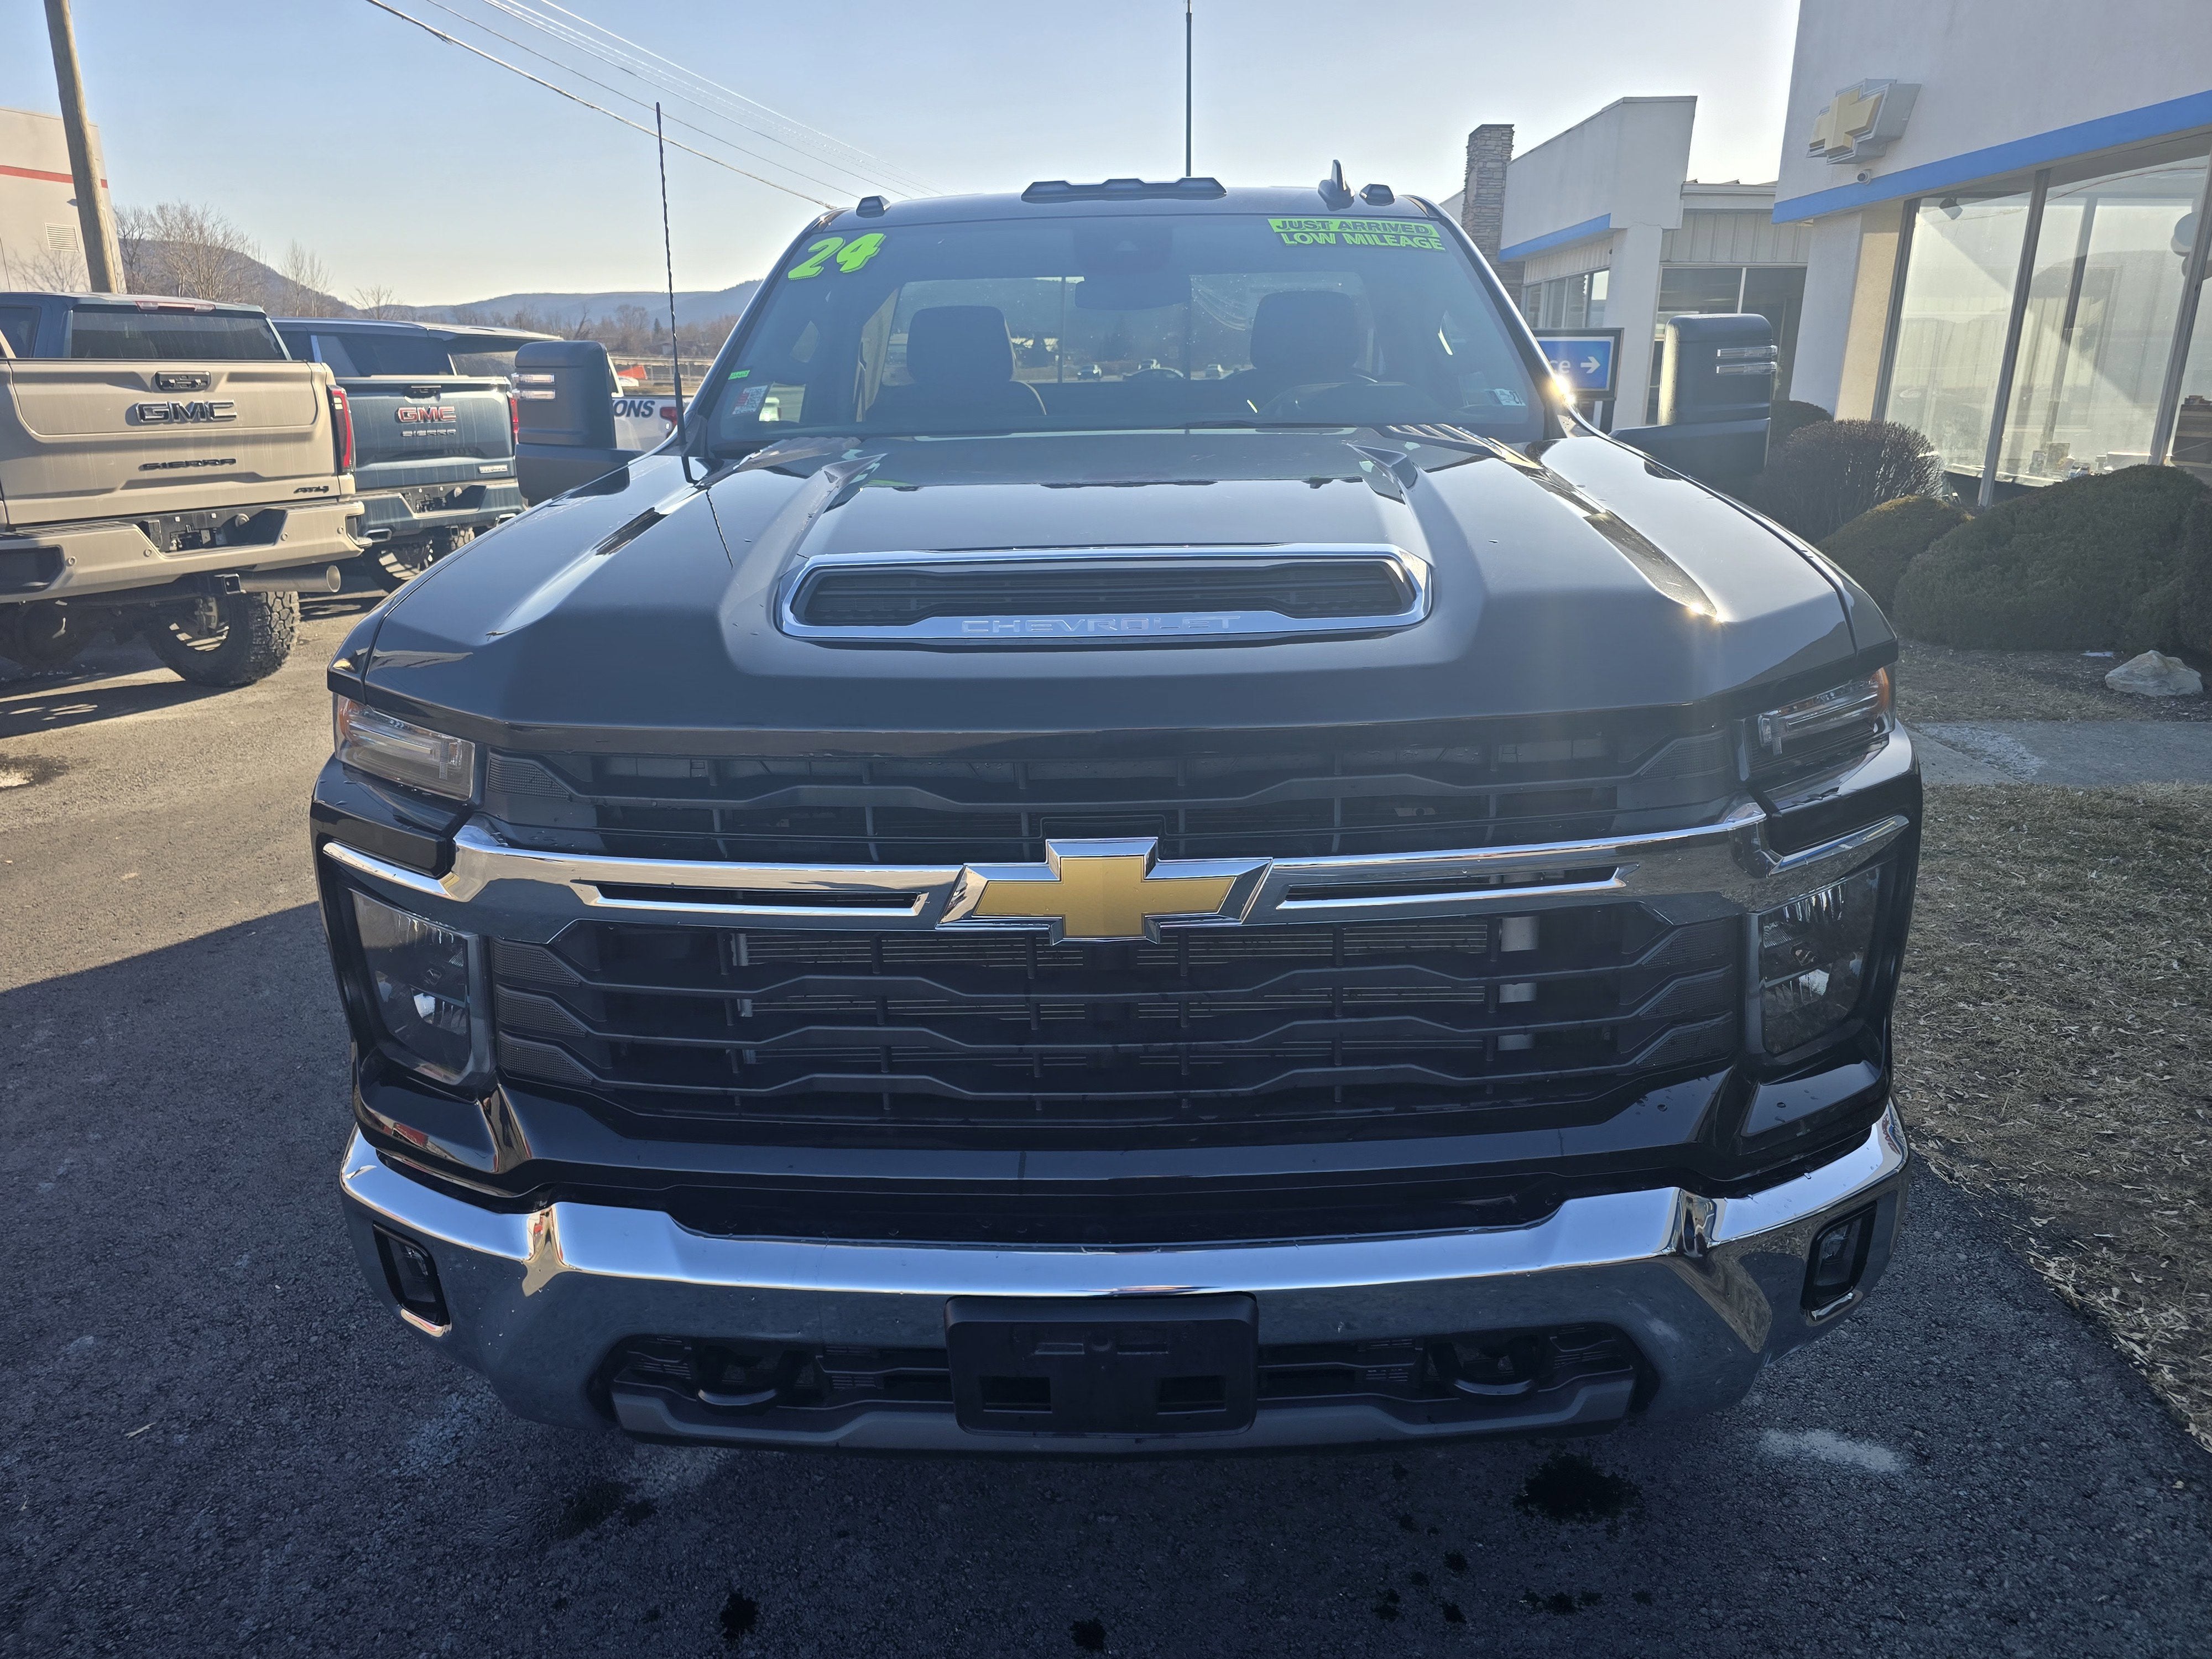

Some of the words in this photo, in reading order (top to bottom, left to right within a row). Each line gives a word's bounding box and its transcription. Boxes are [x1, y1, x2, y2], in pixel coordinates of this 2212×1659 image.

[1276, 220, 1334, 231] JUST
[1338, 221, 1432, 236] ARRIVED
[1281, 233, 1336, 246] LOW
[1342, 233, 1446, 251] MILEAGE
[788, 233, 886, 281] 24
[1550, 360, 1571, 374] ce
[137, 399, 237, 423] GMC
[397, 405, 457, 422] GMC
[613, 400, 655, 418] ONS
[139, 458, 236, 471] SIERRA
[293, 486, 329, 494] AT4
[962, 615, 1240, 633] CHEVROLET
